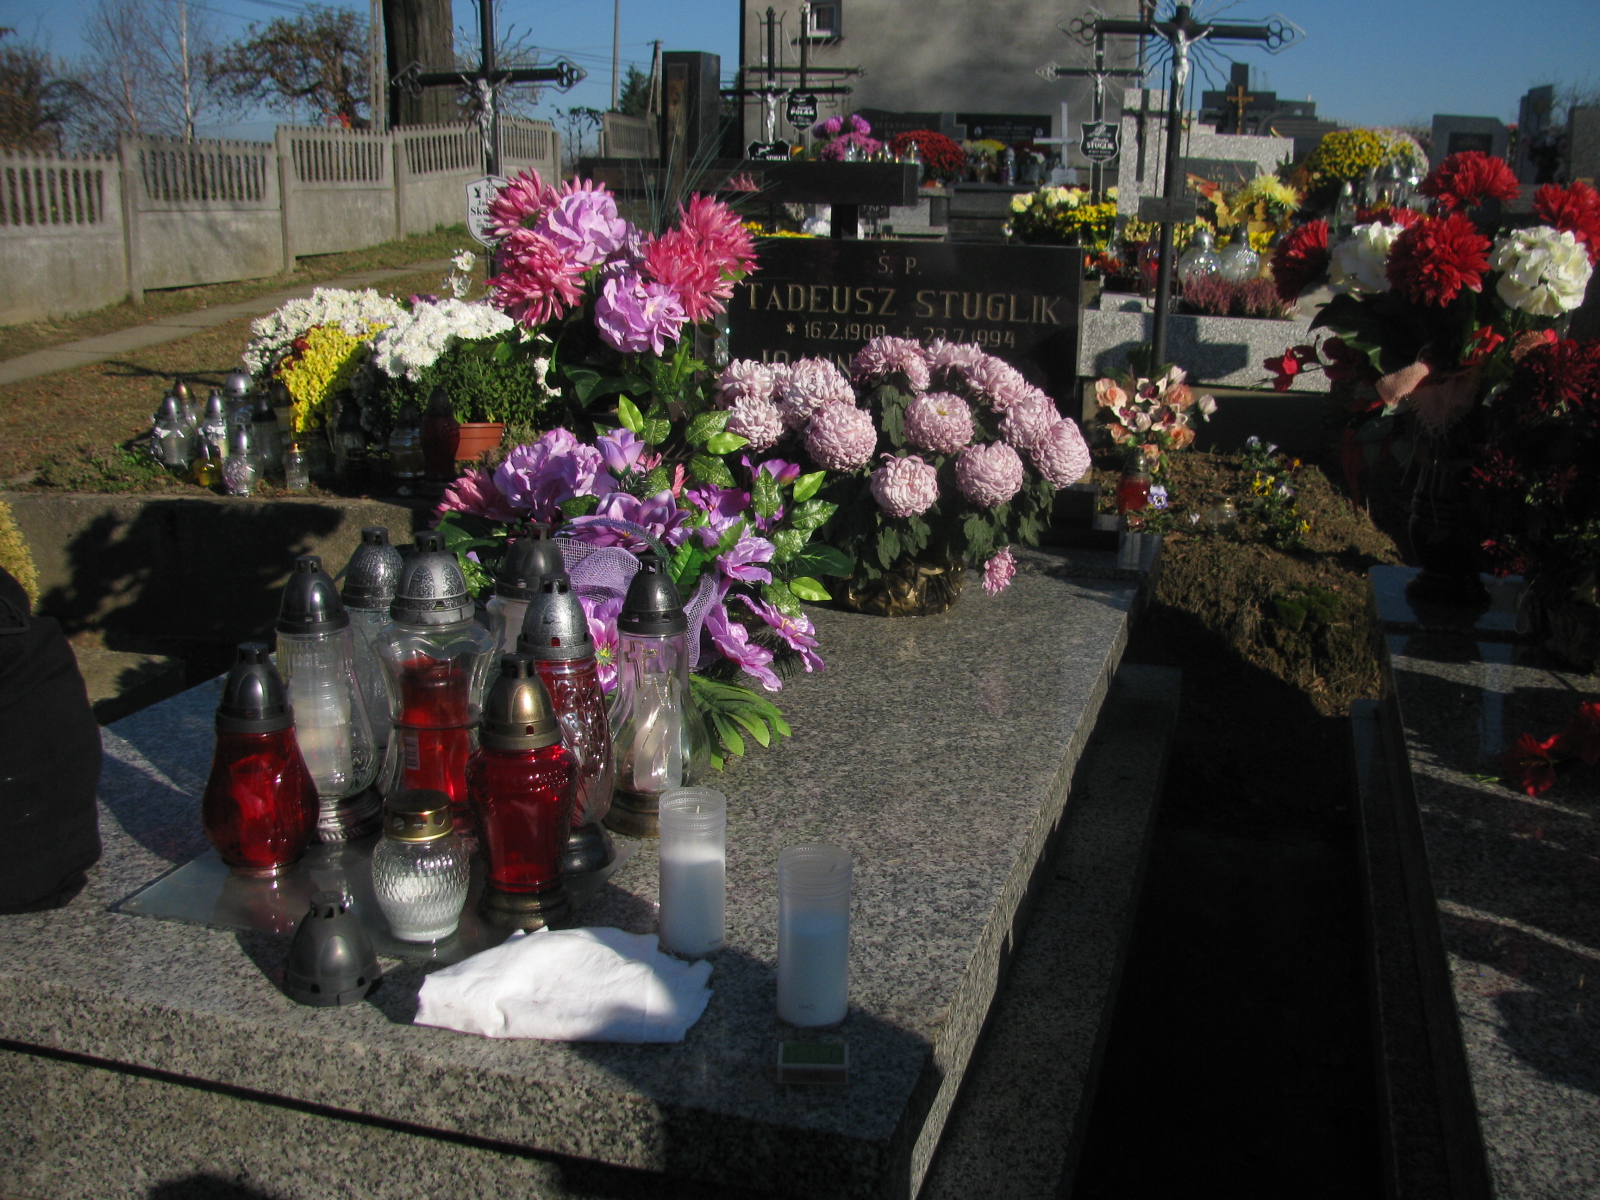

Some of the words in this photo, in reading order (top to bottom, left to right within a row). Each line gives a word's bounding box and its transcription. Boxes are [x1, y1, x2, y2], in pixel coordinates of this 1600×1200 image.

[905, 256, 922, 275] P.
[744, 282, 897, 316] TADEUSZ
[915, 289, 1065, 325] STUGLIK
